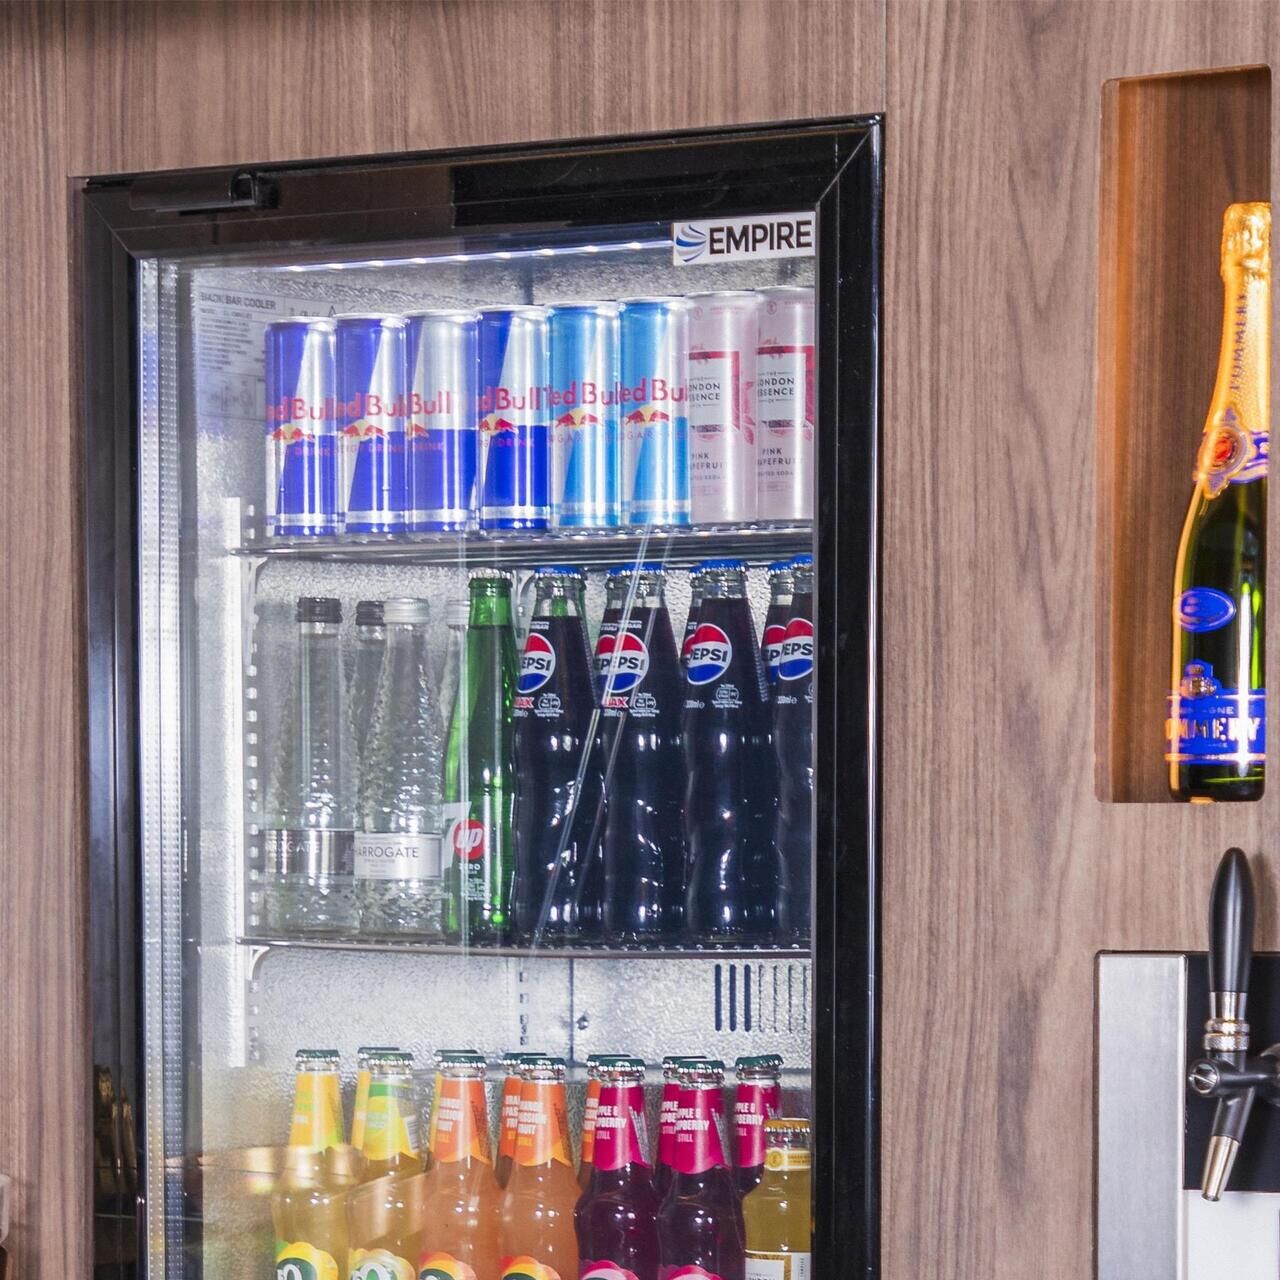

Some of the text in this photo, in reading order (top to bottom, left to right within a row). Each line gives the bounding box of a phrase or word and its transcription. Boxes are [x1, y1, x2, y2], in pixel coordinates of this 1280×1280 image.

[709, 219, 812, 255] EMPIRE
[495, 387, 540, 411] Bull
[690, 647, 727, 663] EPSI
[782, 642, 813, 656] EPS
[521, 656, 552, 671] EPSI
[356, 846, 419, 858] ARROGATE
